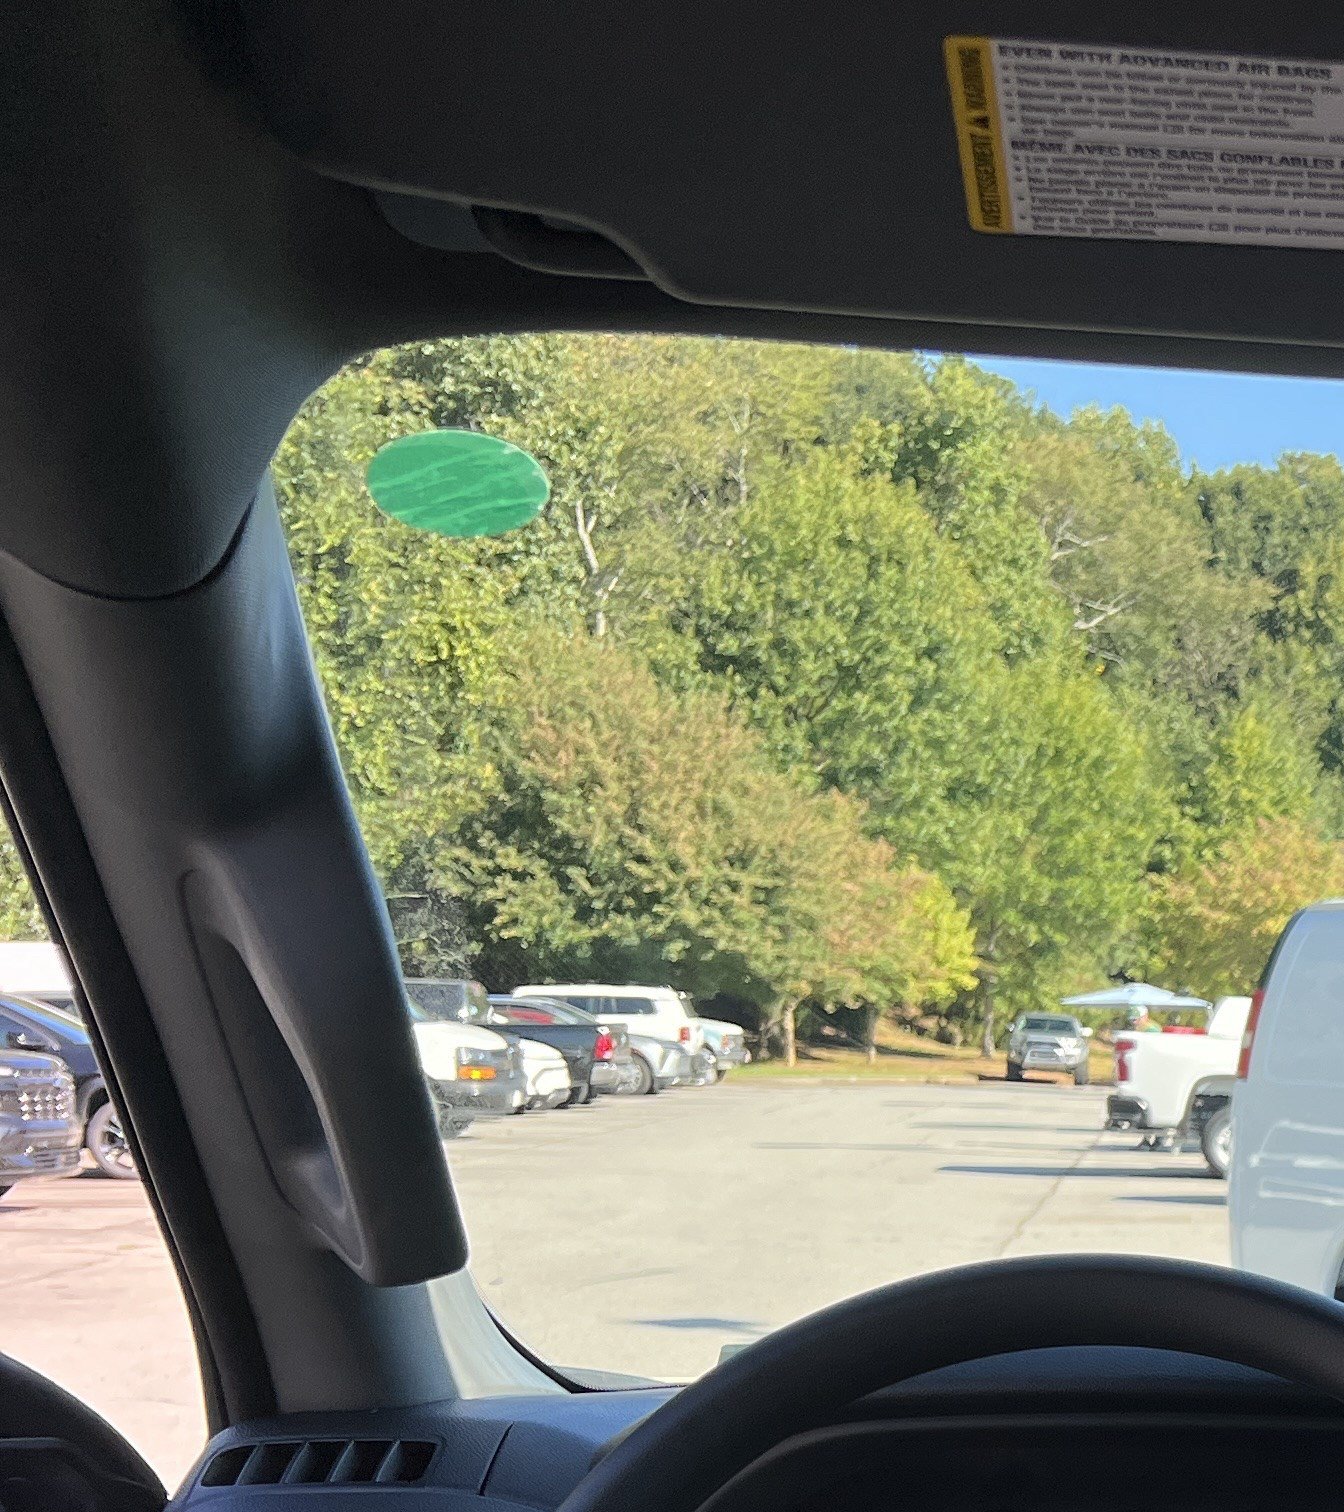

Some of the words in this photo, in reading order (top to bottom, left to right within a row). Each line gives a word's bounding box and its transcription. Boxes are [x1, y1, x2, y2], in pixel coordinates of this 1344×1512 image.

[1121, 53, 1230, 71] ADVANCED
[1238, 62, 1271, 76] AIR
[1277, 65, 1331, 79] BAGS
